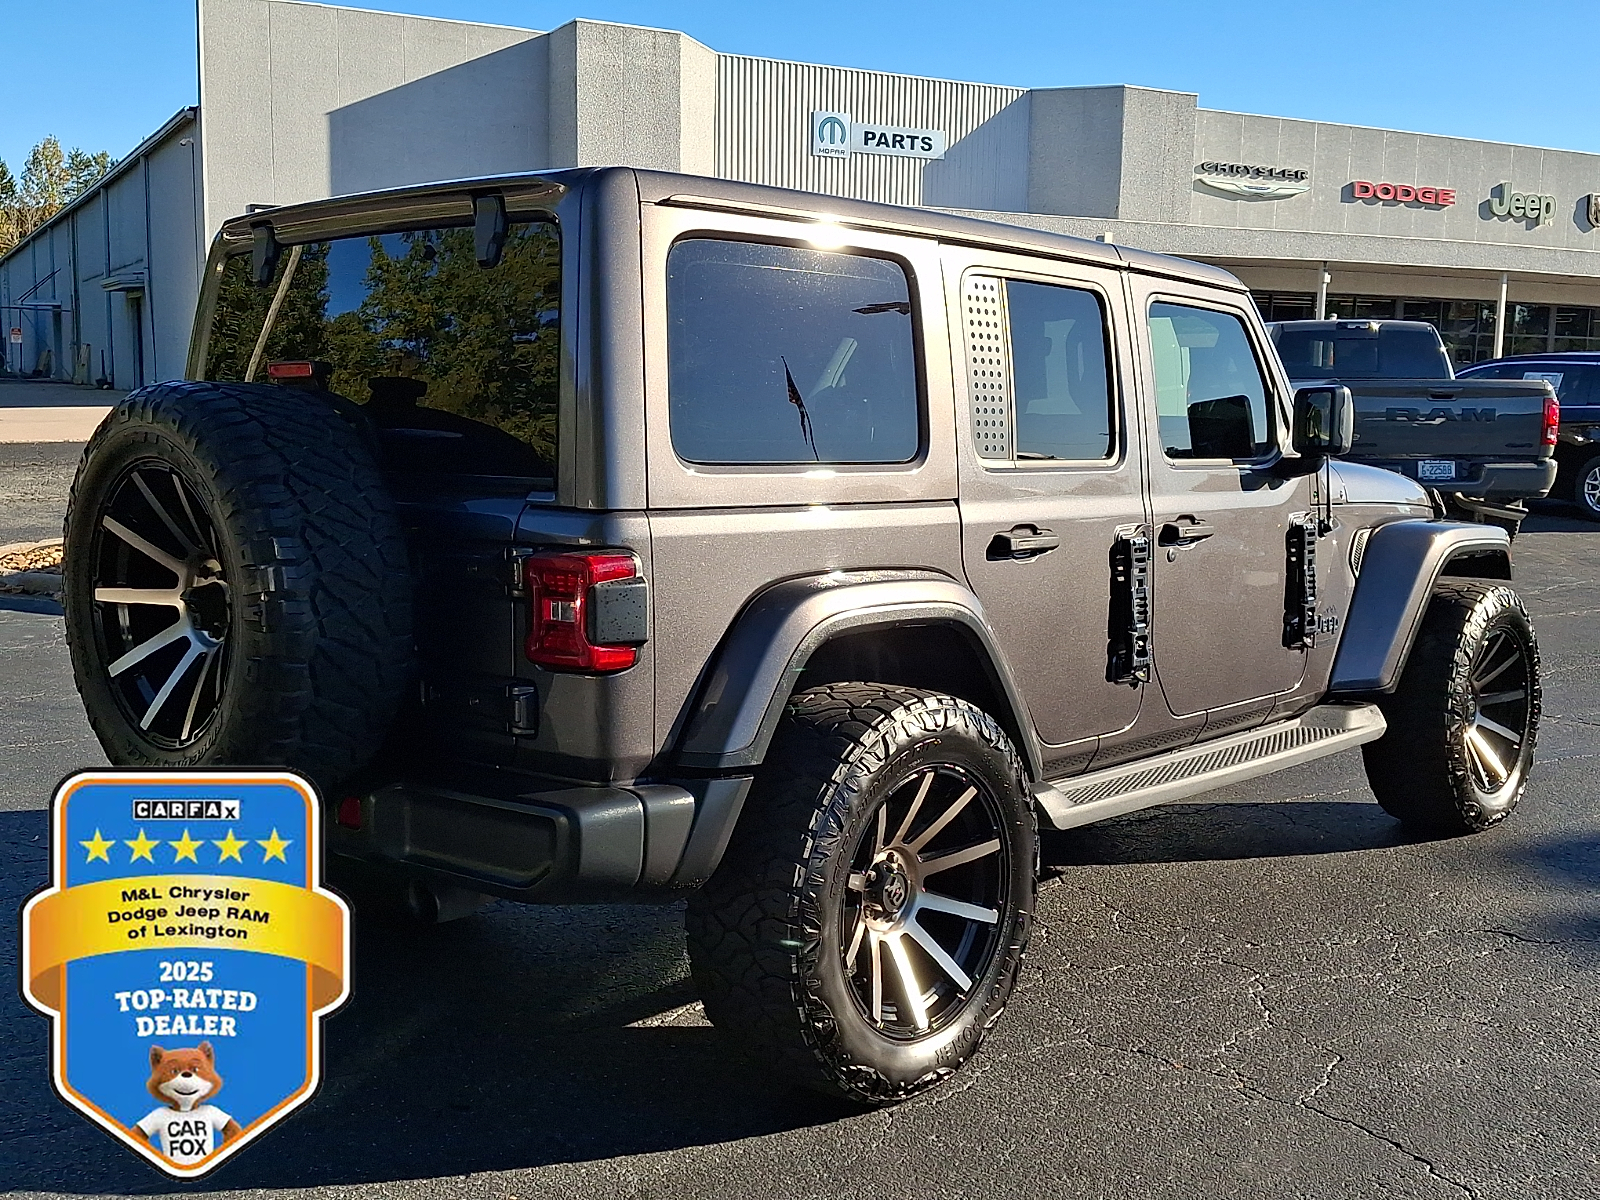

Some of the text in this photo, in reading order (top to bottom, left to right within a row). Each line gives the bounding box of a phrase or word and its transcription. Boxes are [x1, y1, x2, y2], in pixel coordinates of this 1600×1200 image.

[863, 130, 933, 152] PARTS
[818, 147, 846, 156] MOPAR
[1201, 161, 1309, 180] CHRYSLER
[1354, 181, 1456, 205] DODGE
[1490, 182, 1556, 226] Jeep
[1386, 407, 1497, 422] RAM
